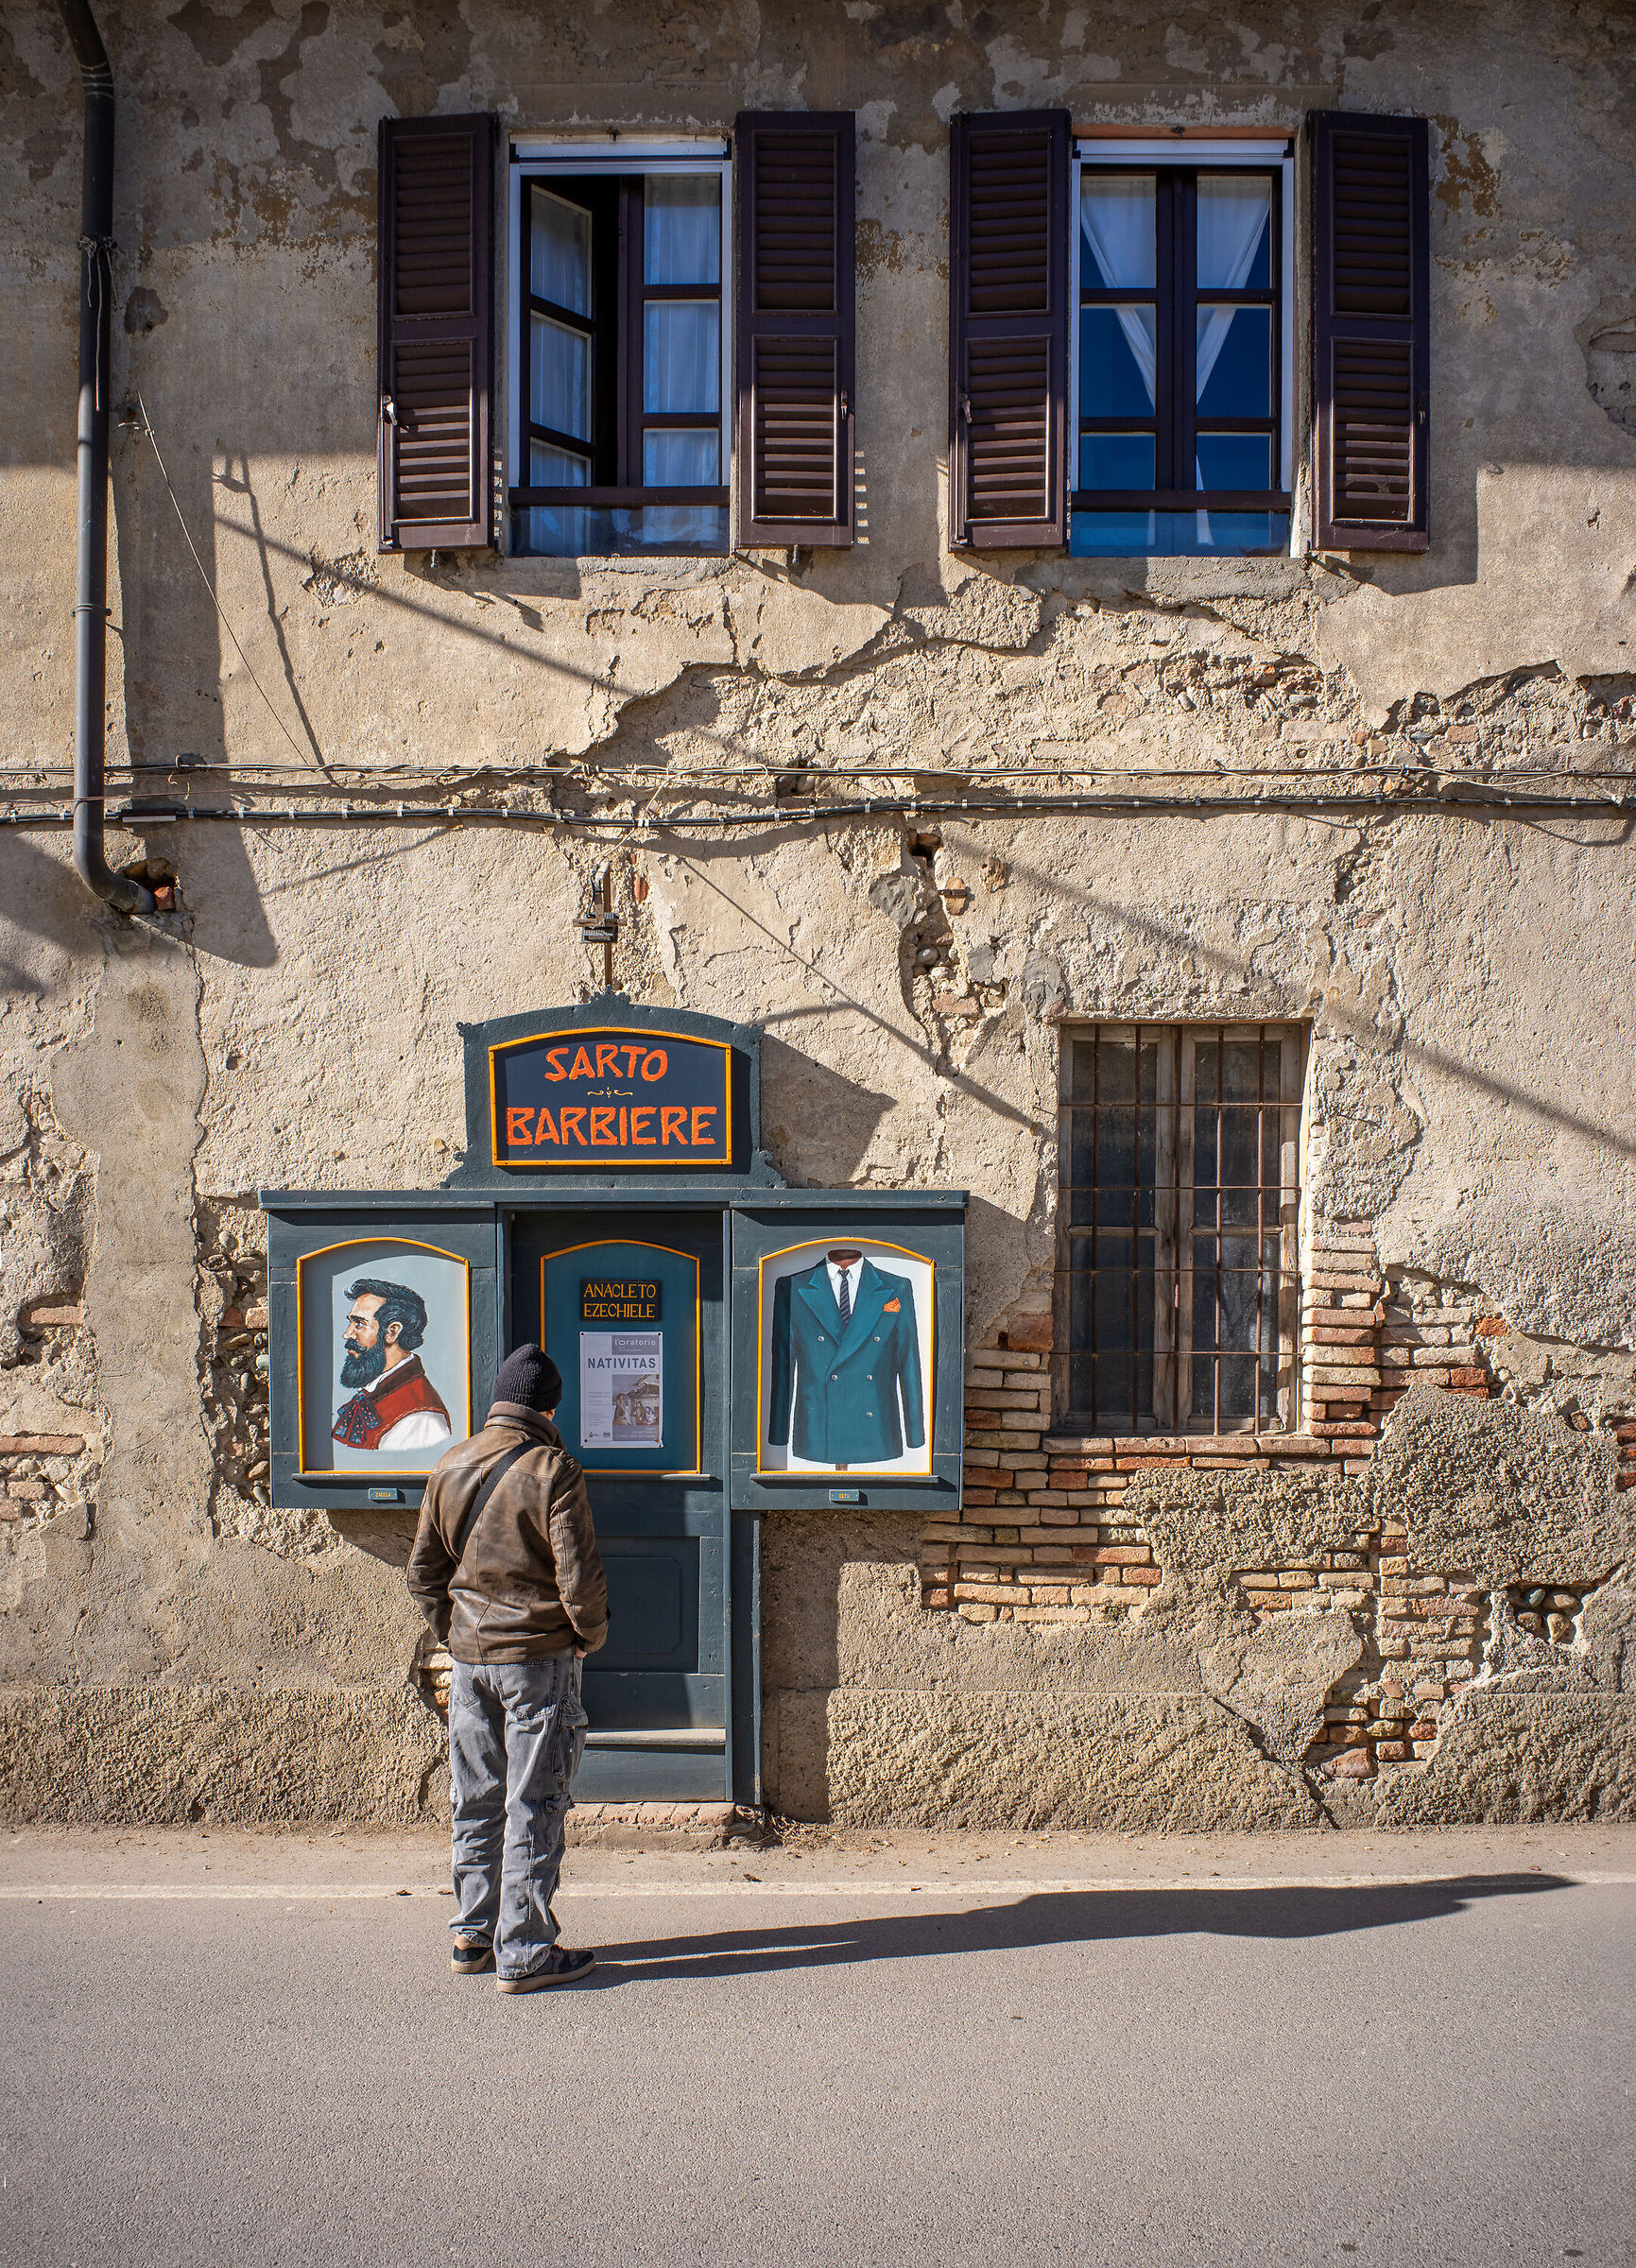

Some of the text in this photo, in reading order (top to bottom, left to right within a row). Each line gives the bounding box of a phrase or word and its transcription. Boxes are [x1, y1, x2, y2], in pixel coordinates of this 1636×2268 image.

[544, 1043, 668, 1082] SARTO
[507, 1106, 717, 1146] BARBIERE
[583, 1283, 657, 1298] ANACLETO
[584, 1303, 656, 1318] EZECHIELE
[588, 1358, 657, 1369] NATIVITAS
